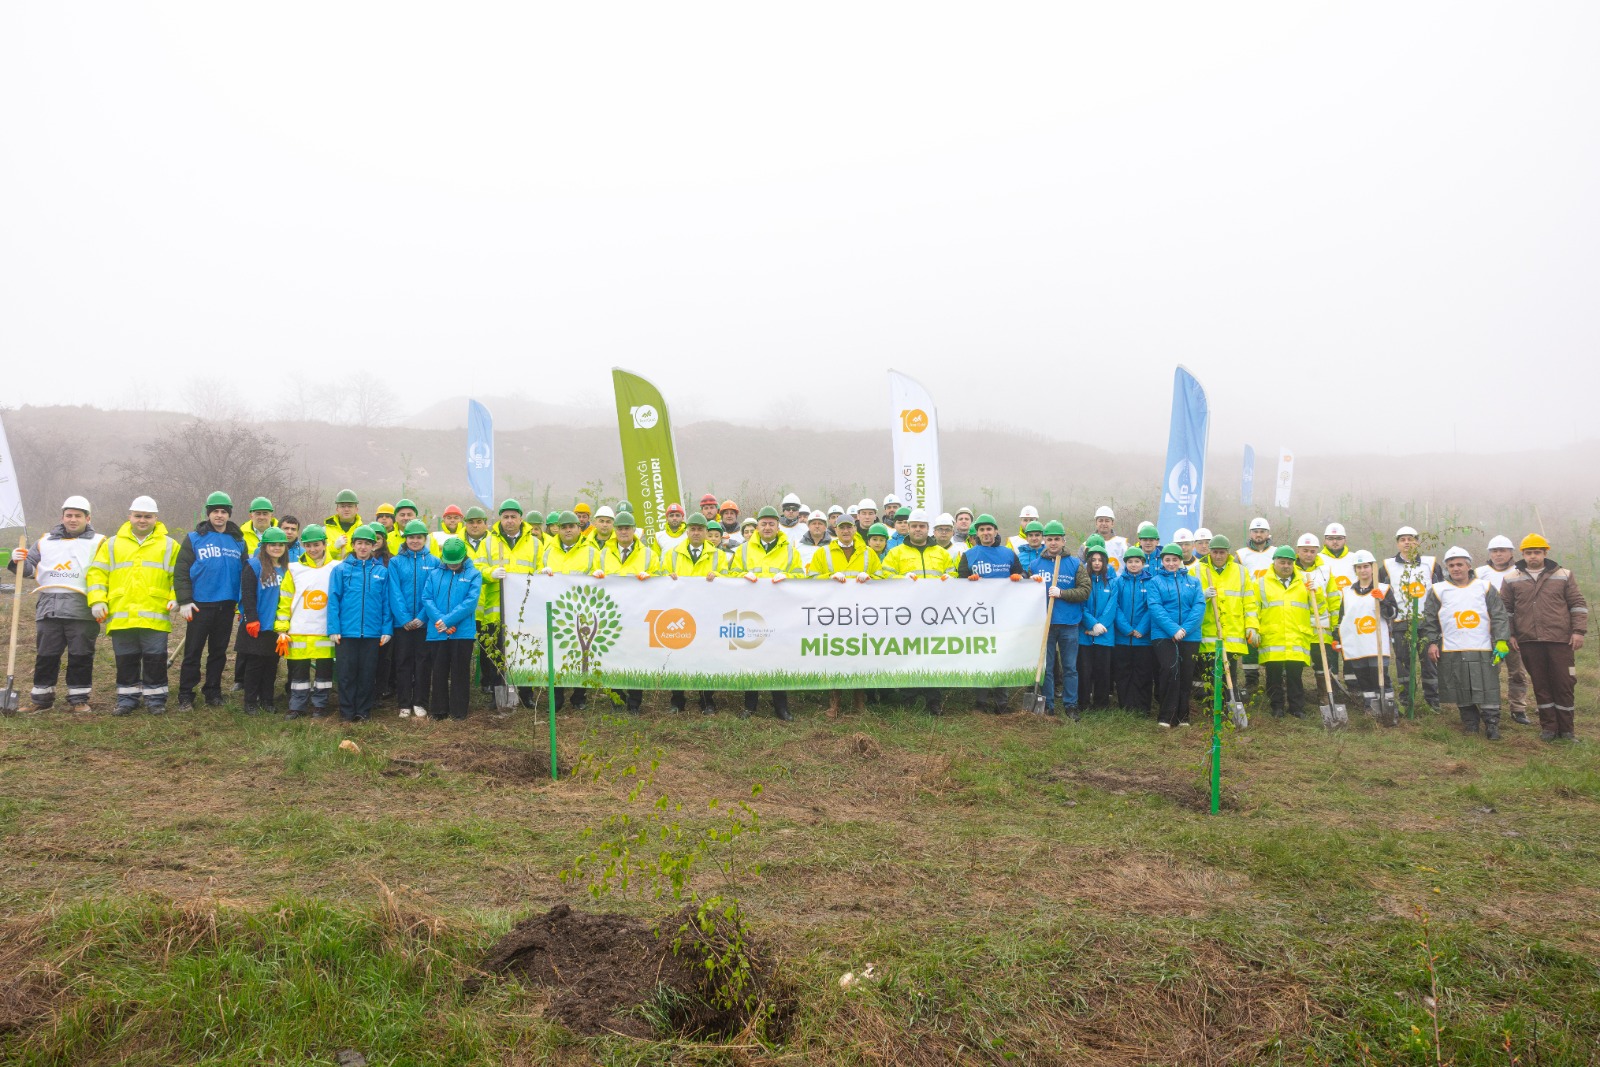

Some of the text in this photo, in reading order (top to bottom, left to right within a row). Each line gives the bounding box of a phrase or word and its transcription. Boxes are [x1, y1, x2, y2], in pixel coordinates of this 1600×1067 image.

[650, 457, 667, 531] SİYAMIZDIR!
[916, 463, 926, 509] MIZDIR!
[643, 500, 656, 545] ƏBİƏTƏ
[801, 602, 996, 626] TƏBİƏTƏ QAYĞI
[800, 633, 997, 656] MİSSİYAMIZDIR!
